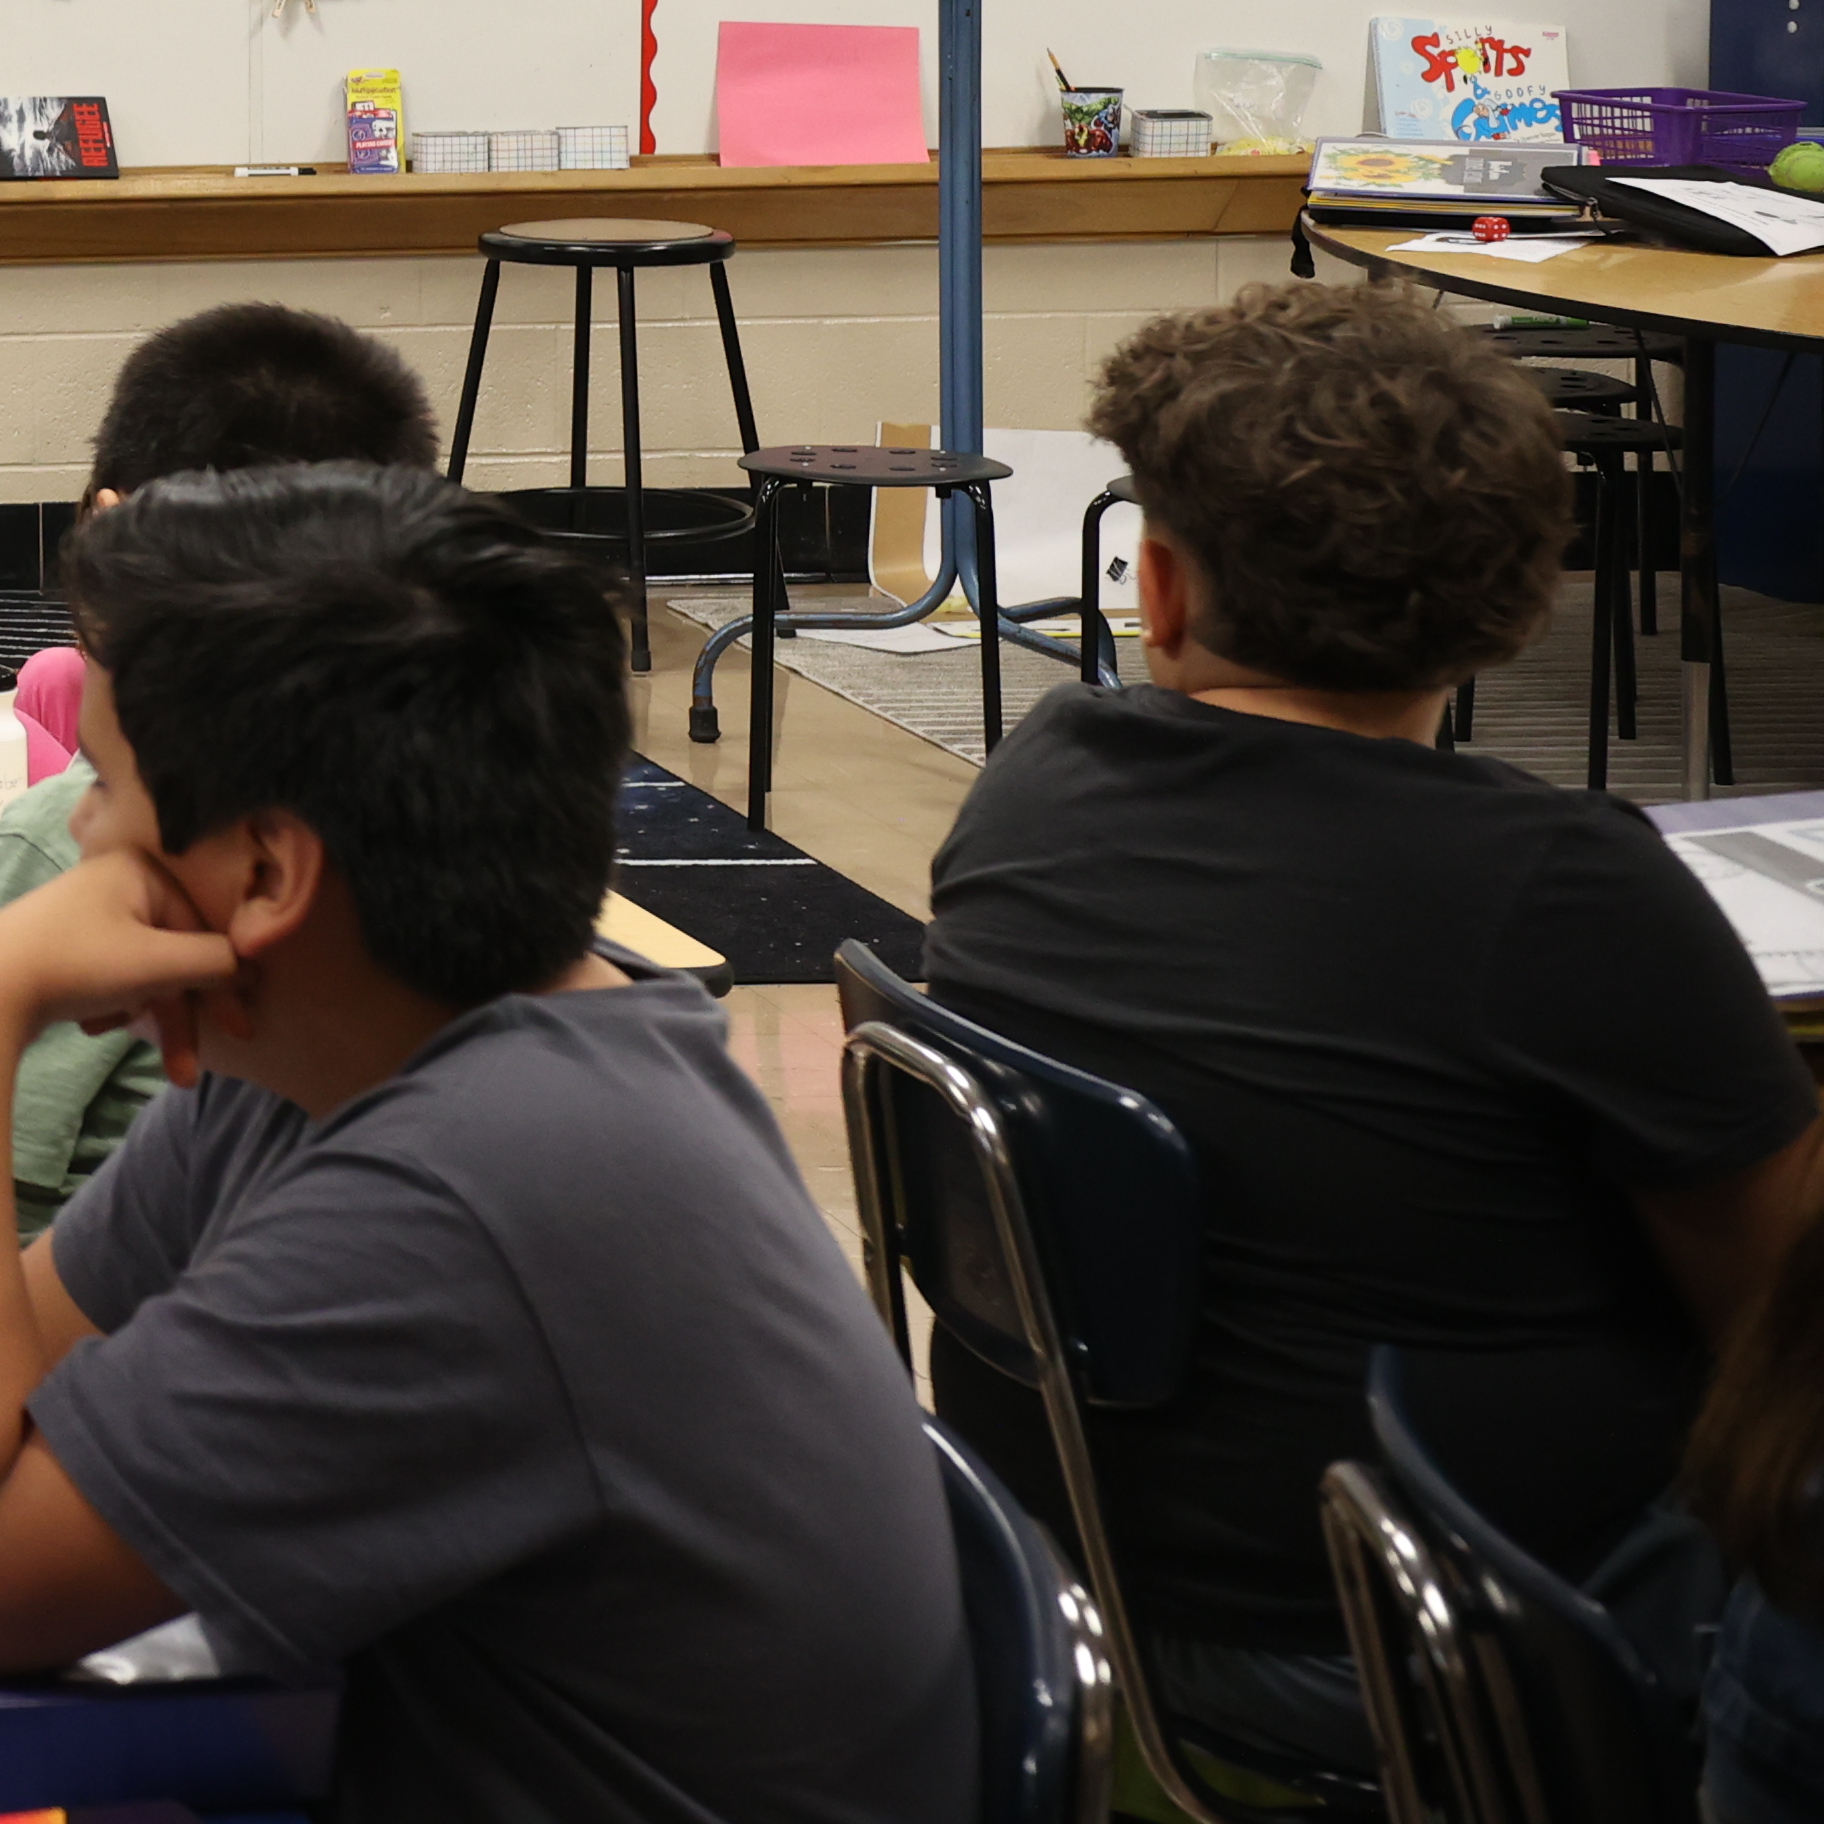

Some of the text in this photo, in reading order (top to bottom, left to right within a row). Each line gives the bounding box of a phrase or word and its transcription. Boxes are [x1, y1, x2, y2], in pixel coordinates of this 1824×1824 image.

[1446, 25, 1492, 45] SILLY
[1494, 85, 1546, 101] GOOFY
[73, 103, 110, 167] REFUGEE
